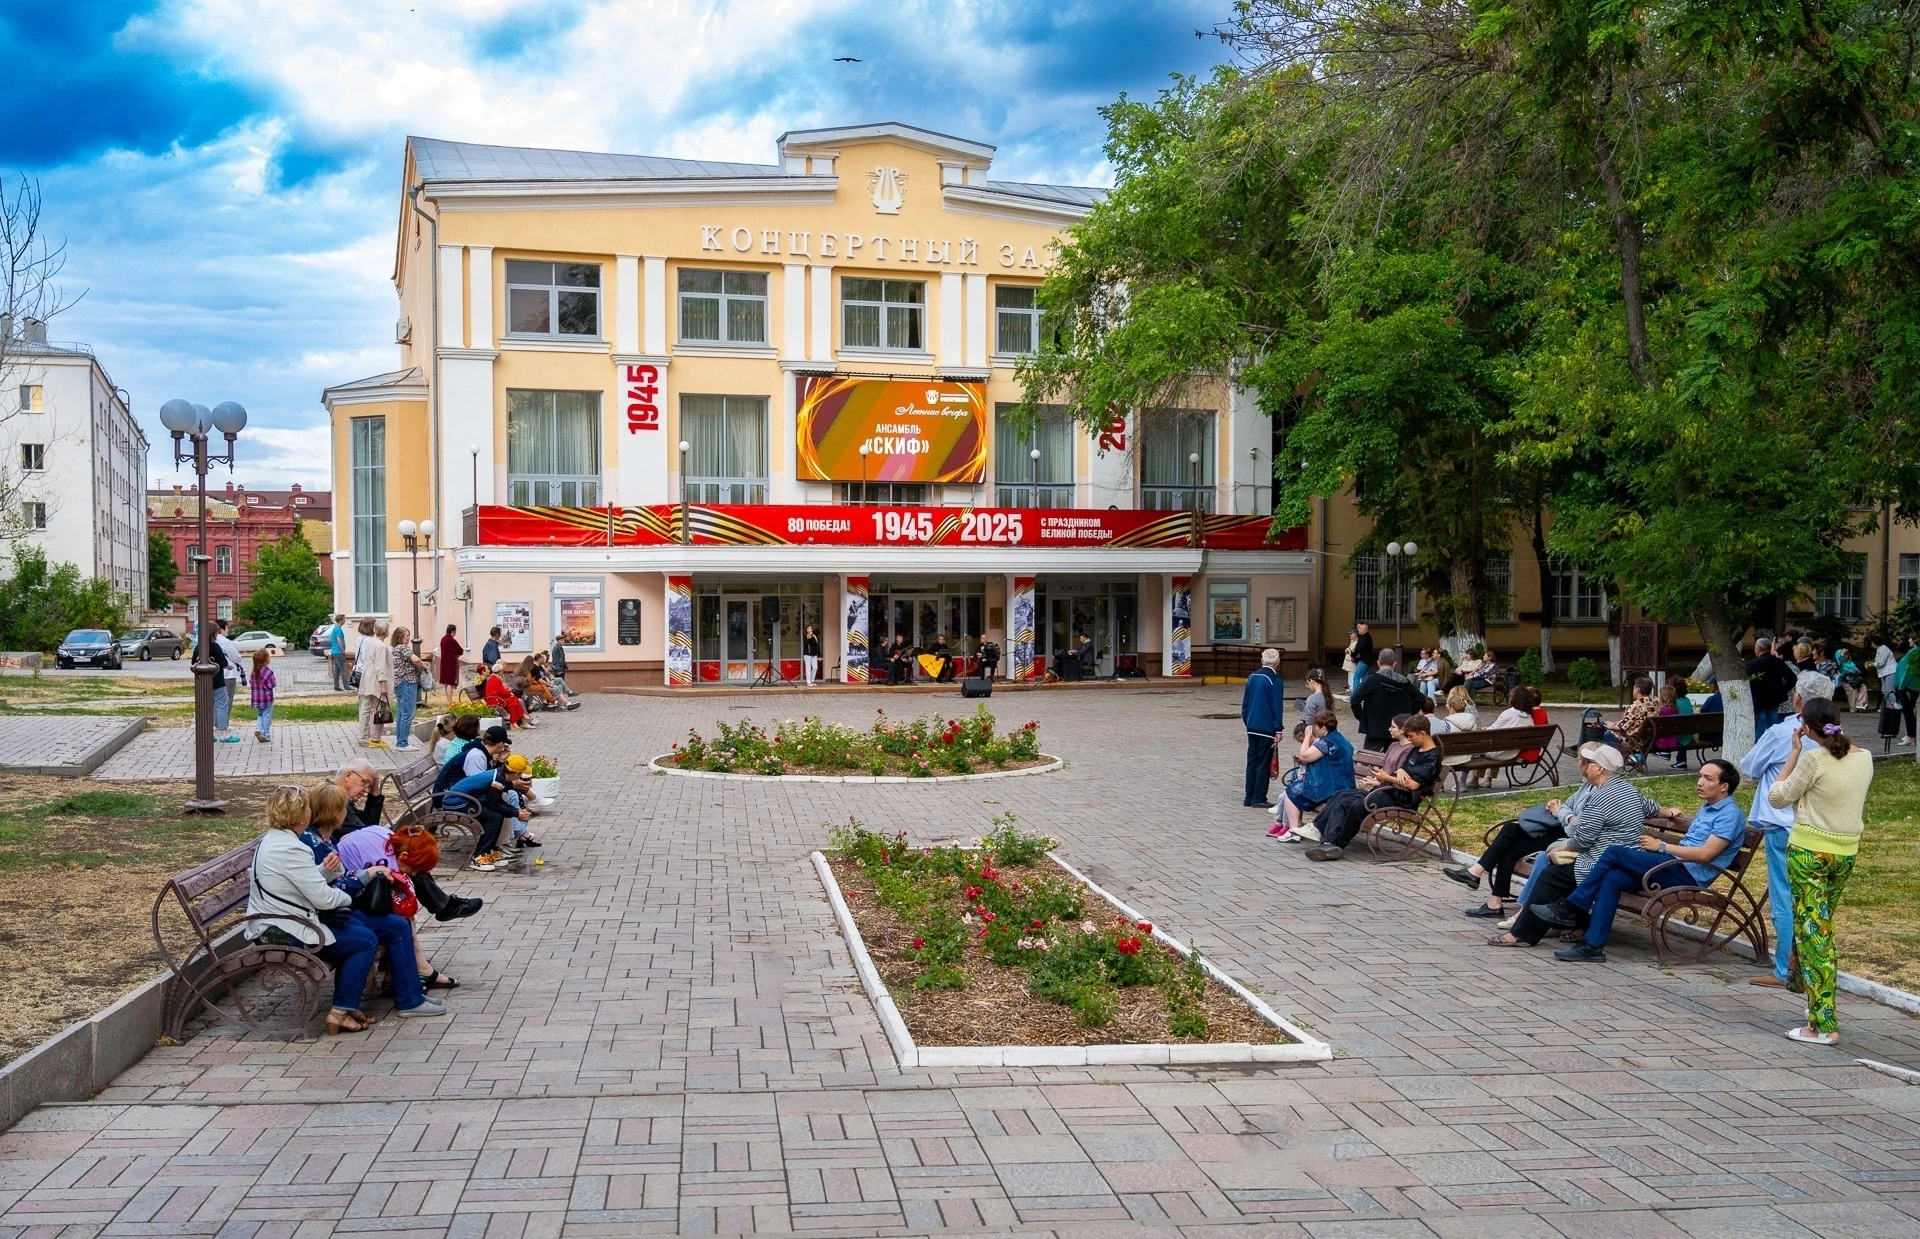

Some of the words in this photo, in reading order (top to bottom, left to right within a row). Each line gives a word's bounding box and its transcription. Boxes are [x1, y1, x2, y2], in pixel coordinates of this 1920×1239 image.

[702, 225, 979, 265] КОНЦЕРТНЫЙ
[999, 245, 1063, 270] ЗАЛ
[627, 364, 659, 434] 1945
[875, 424, 922, 434] АНСАМБЛЬ
[865, 437, 930, 455] «СКИФ»
[788, 517, 805, 533] 80
[806, 519, 850, 532] ПОБЕДА!
[872, 511, 933, 541] 1945
[961, 513, 1023, 542] 2025
[1041, 518, 1047, 527] С
[1048, 518, 1101, 528] ПРАЗДНИКОМ
[1041, 528, 1077, 538] ВЕЛИКОЙ
[1078, 530, 1113, 539] ПОБЕДЫ!
